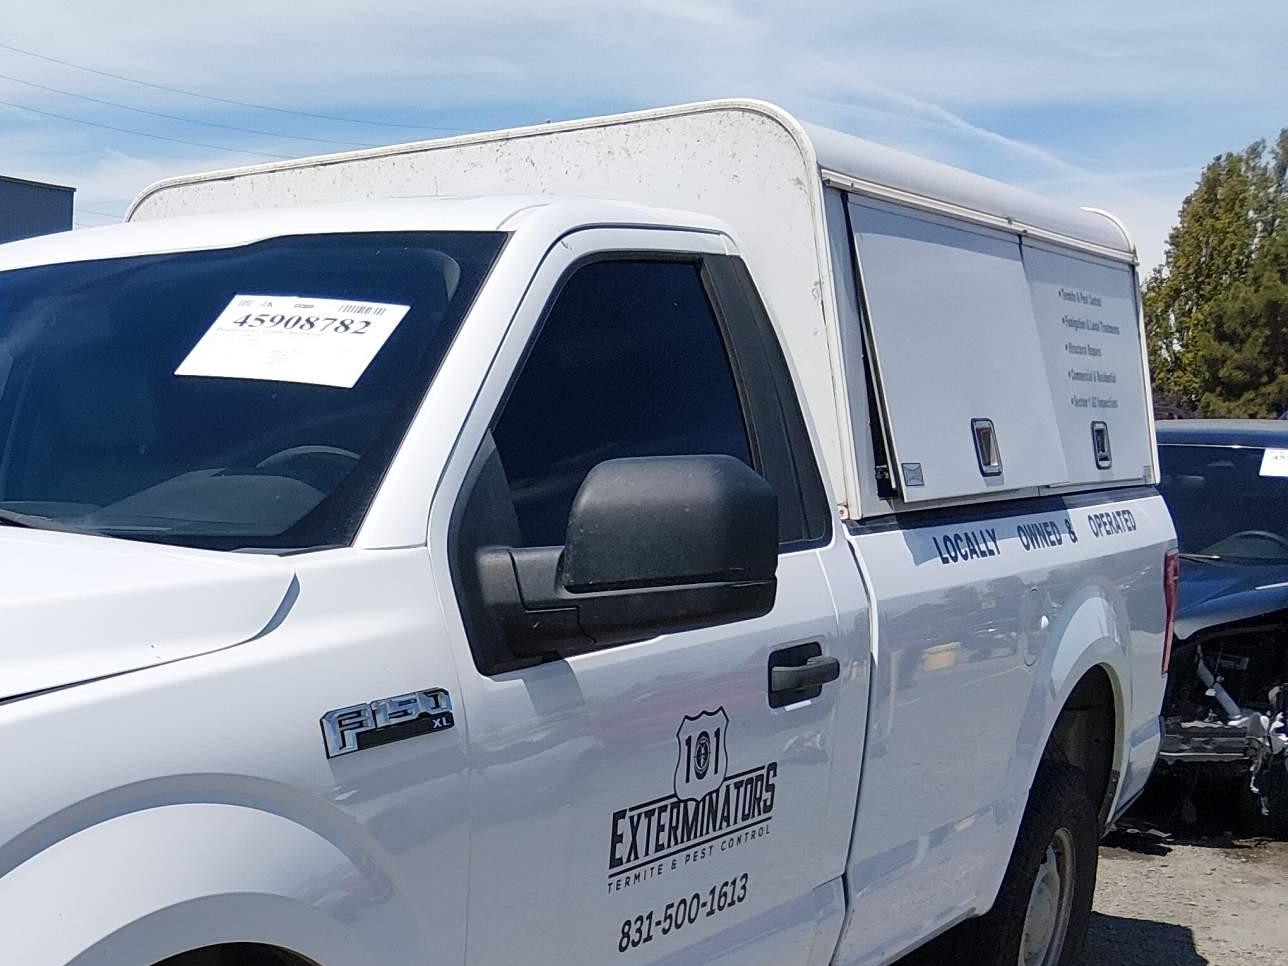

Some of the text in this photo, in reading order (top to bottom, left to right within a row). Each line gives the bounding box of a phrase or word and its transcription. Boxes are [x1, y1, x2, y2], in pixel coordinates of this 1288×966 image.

[233, 312, 372, 336] 45908782
[933, 509, 1138, 565] LOCALLY OWNED & OPERATED
[432, 716, 453, 729] XL
[684, 727, 721, 784] 101
[608, 761, 778, 870] EXTERMINATORS
[607, 824, 771, 894] TERMITE & PEST CONTROL
[618, 872, 749, 953] 831-500-1613
